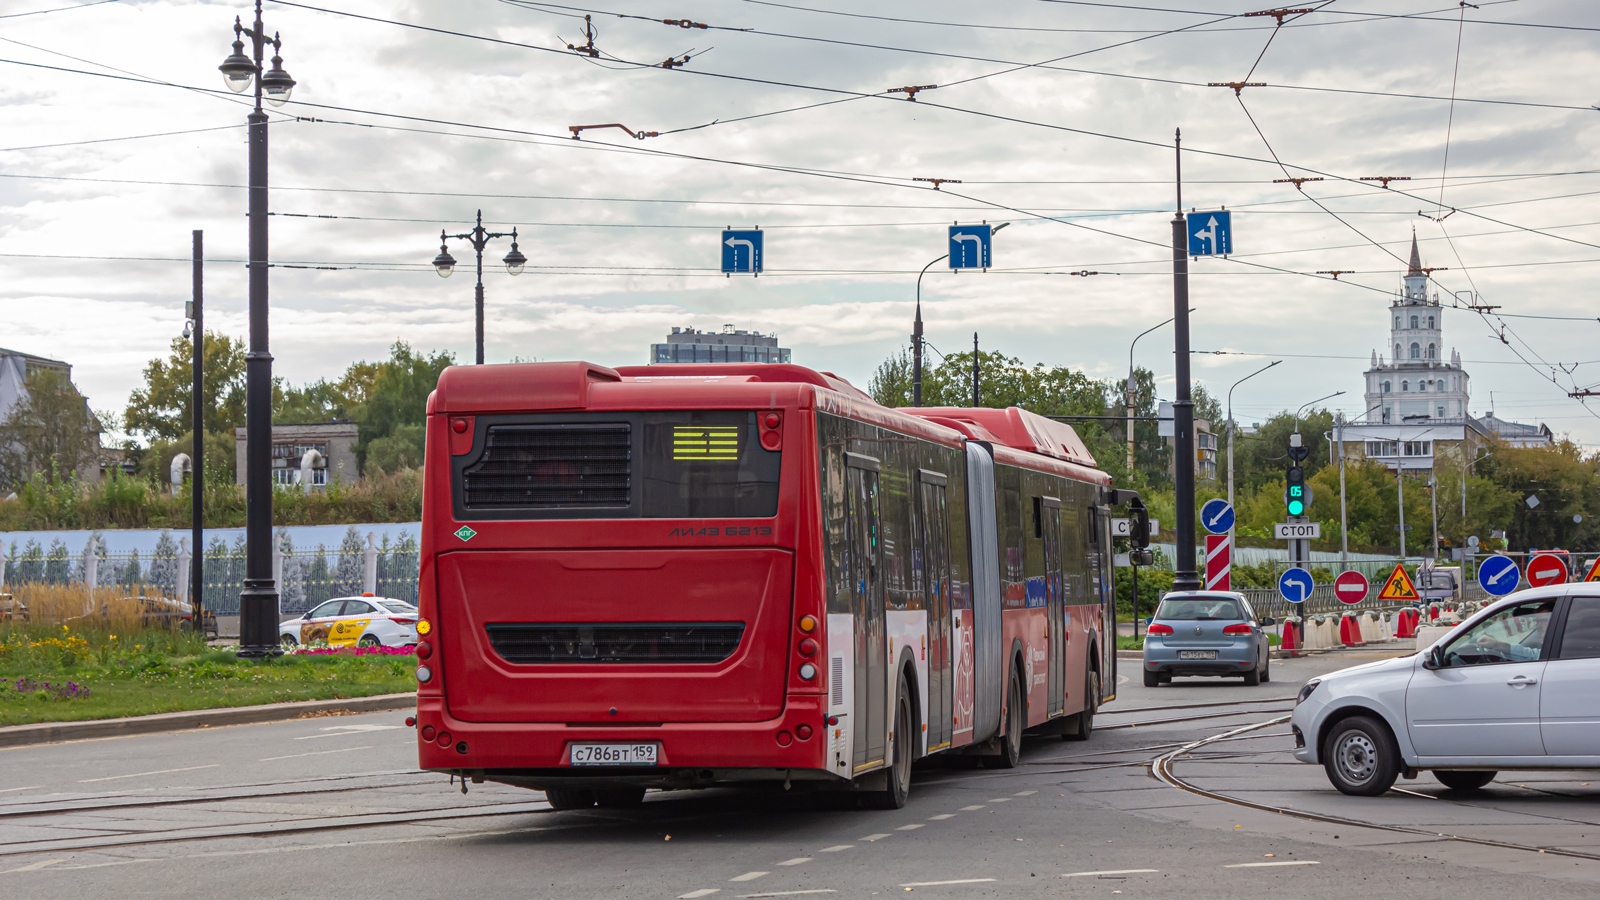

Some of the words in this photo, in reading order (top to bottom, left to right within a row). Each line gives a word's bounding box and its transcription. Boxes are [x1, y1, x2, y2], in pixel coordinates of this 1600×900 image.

[1290, 485, 1302, 497] 05
[667, 526, 720, 537] ЛИАЗ
[725, 526, 772, 536] 6213
[1281, 525, 1314, 537] СТОП
[575, 746, 630, 761] С786ВТ
[632, 745, 654, 757] 159
